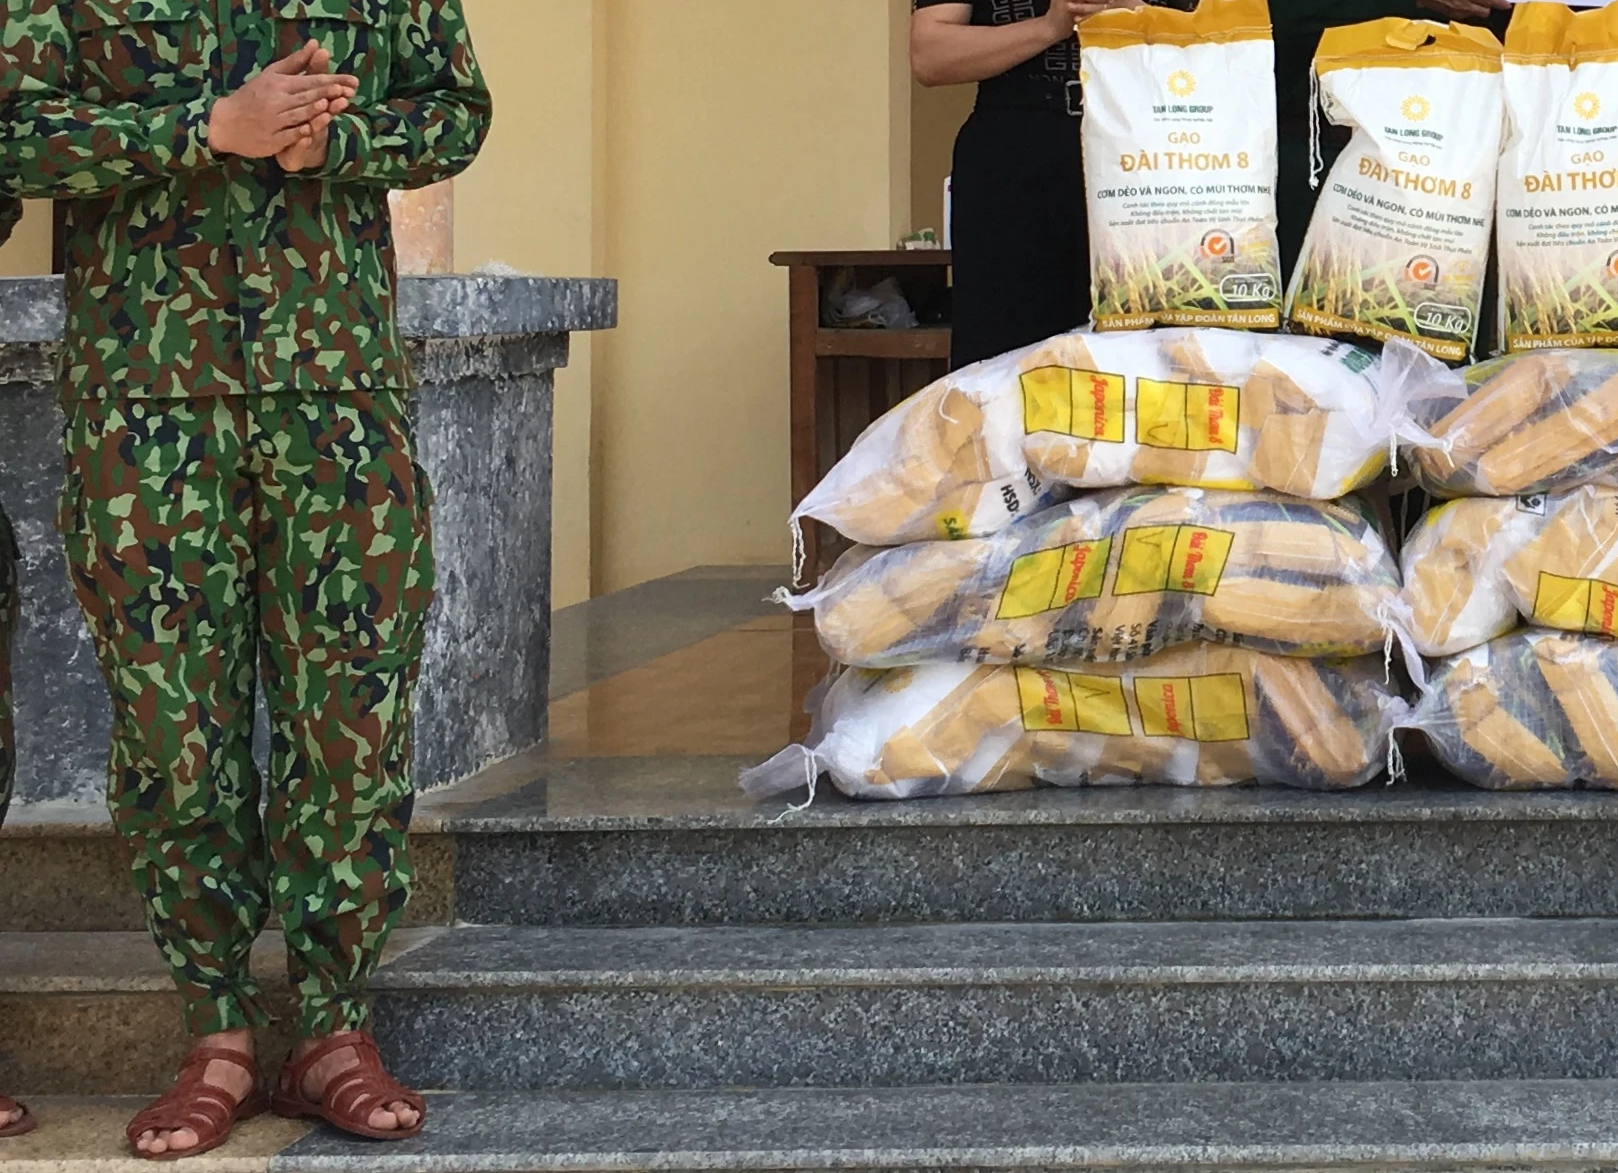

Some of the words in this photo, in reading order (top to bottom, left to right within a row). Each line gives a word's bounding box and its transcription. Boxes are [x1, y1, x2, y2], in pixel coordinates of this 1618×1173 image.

[1168, 132, 1201, 146] GẠO
[1120, 149, 1158, 172] ĐÀI
[1163, 151, 1231, 171] THƠM
[1237, 151, 1249, 169] 8
[1398, 151, 1431, 167] GẠO
[1571, 150, 1604, 166] GẠO
[1139, 185, 1152, 196] VÀ
[1155, 186, 1187, 195] NGON,
[1227, 184, 1256, 194] THƠM
[1392, 169, 1456, 198] THƠM
[1461, 182, 1472, 200] 8
[1524, 170, 1561, 193] ĐÀI
[1544, 206, 1556, 217] VÀ
[1559, 207, 1592, 217] NGON,
[1232, 284, 1248, 296] 10
[1252, 285, 1270, 301] Kg
[1248, 314, 1275, 323] LONG
[1426, 312, 1442, 325] 10
[1445, 314, 1464, 333] Kg
[1436, 343, 1463, 356] LONG
[1090, 374, 1109, 437] Japonica
[1001, 484, 1020, 517] HSD:
[1064, 544, 1093, 604] Japonica
